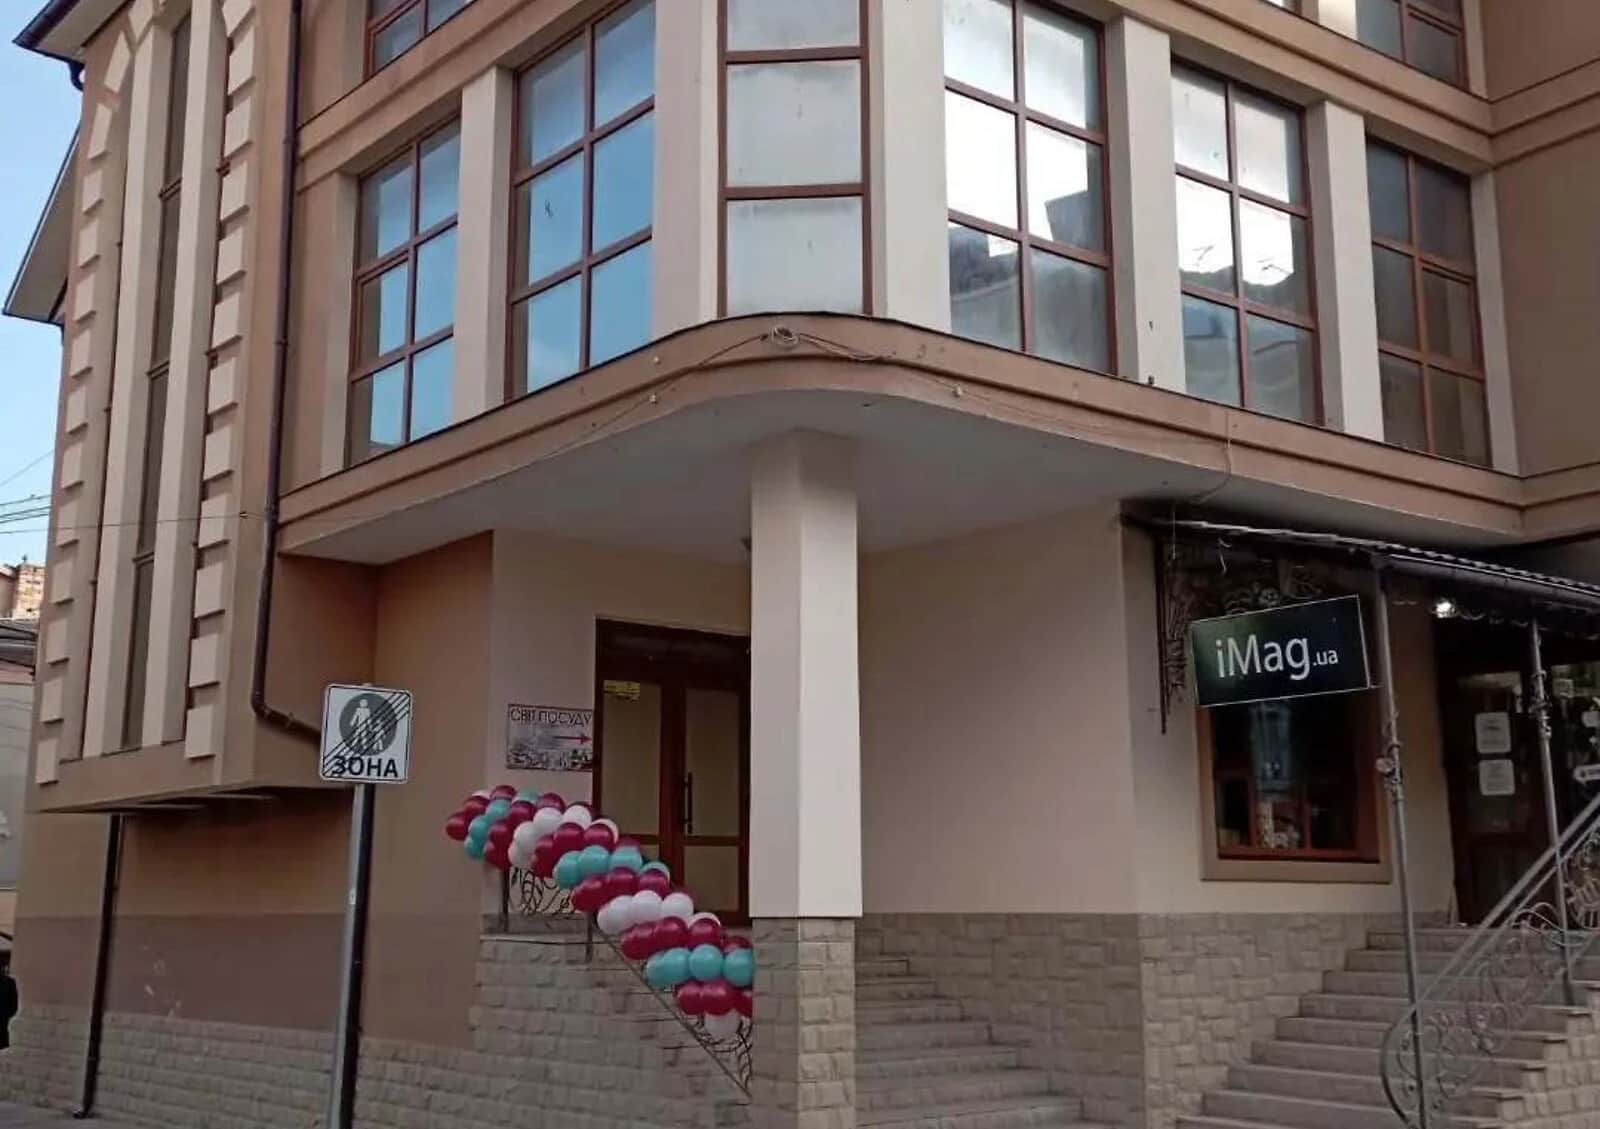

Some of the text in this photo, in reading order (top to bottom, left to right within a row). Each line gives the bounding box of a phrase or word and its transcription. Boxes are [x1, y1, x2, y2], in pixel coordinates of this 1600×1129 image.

[1215, 634, 1339, 680] iMag.ua
[539, 710, 592, 727] ПОСУДУ
[331, 755, 398, 778] ЗОНА
